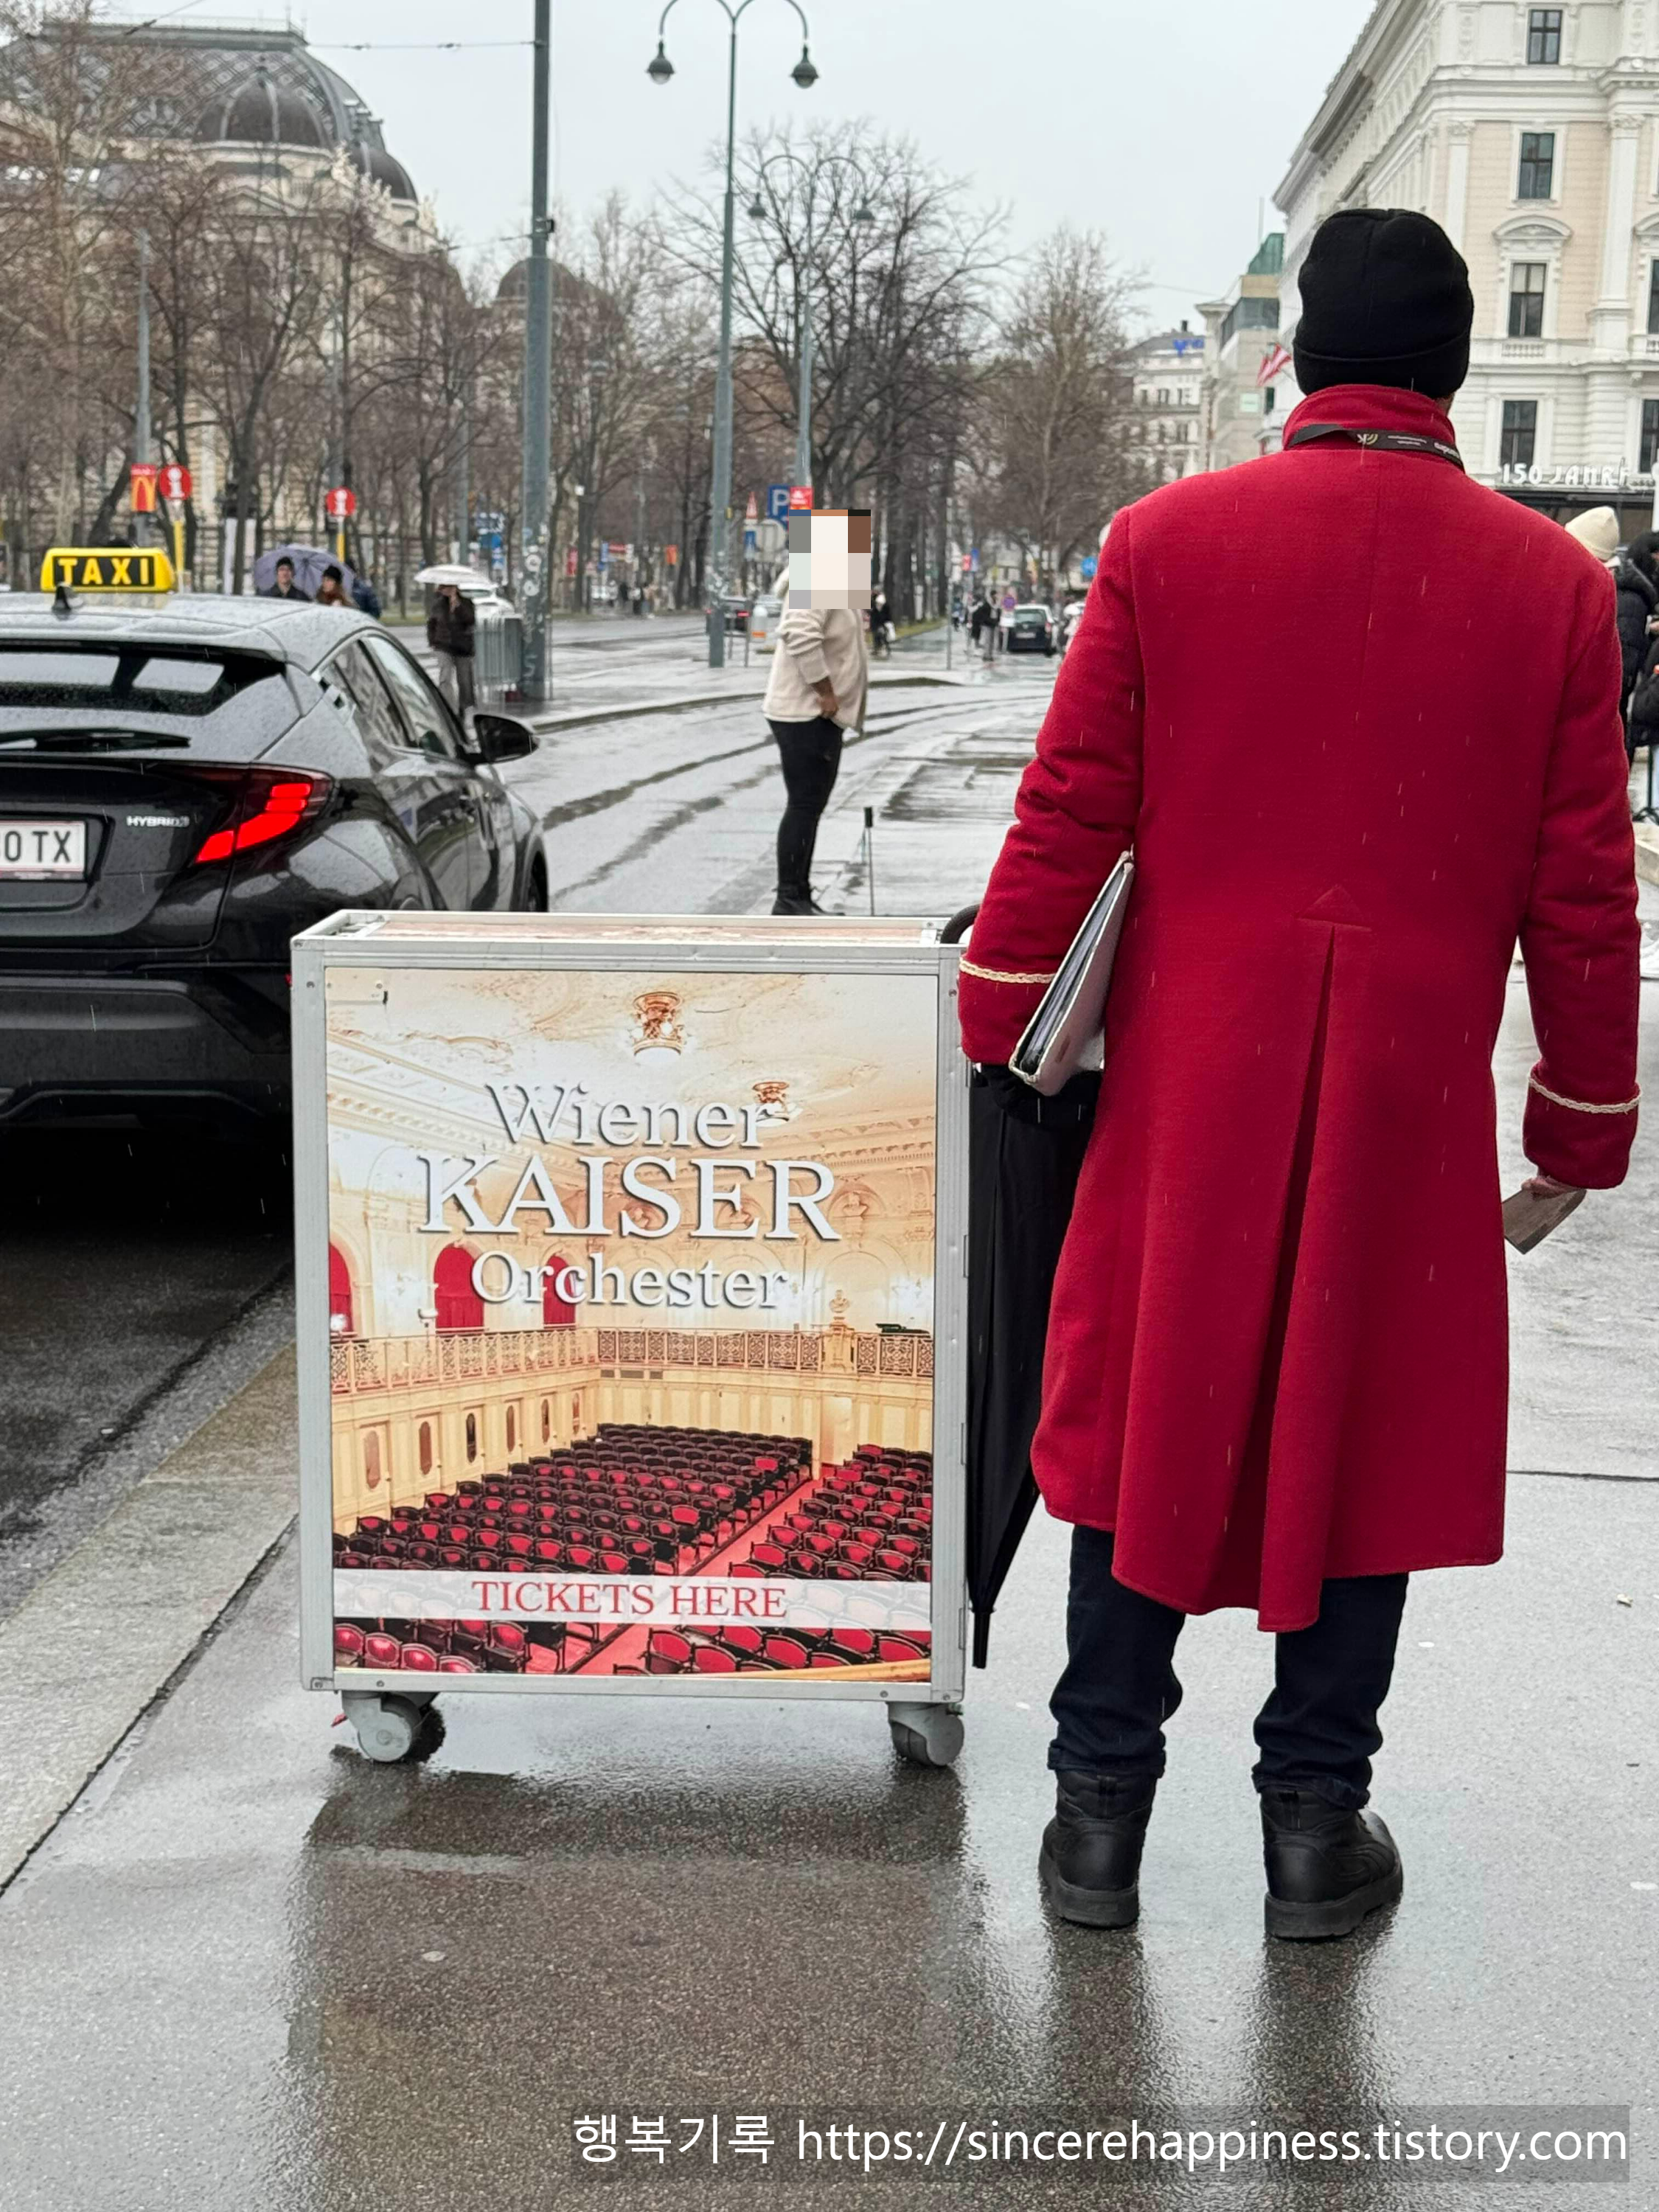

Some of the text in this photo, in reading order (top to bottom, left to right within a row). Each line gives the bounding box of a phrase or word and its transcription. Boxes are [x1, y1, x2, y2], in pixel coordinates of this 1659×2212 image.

[1503, 463, 1543, 484] 150
[58, 557, 149, 585] TAXI
[32, 830, 71, 863] TX
[484, 1082, 774, 1149] Wiener
[417, 1153, 842, 1241] KAISER
[471, 1250, 789, 1309] Orchester
[471, 1580, 787, 1618] TICKETS HERE
